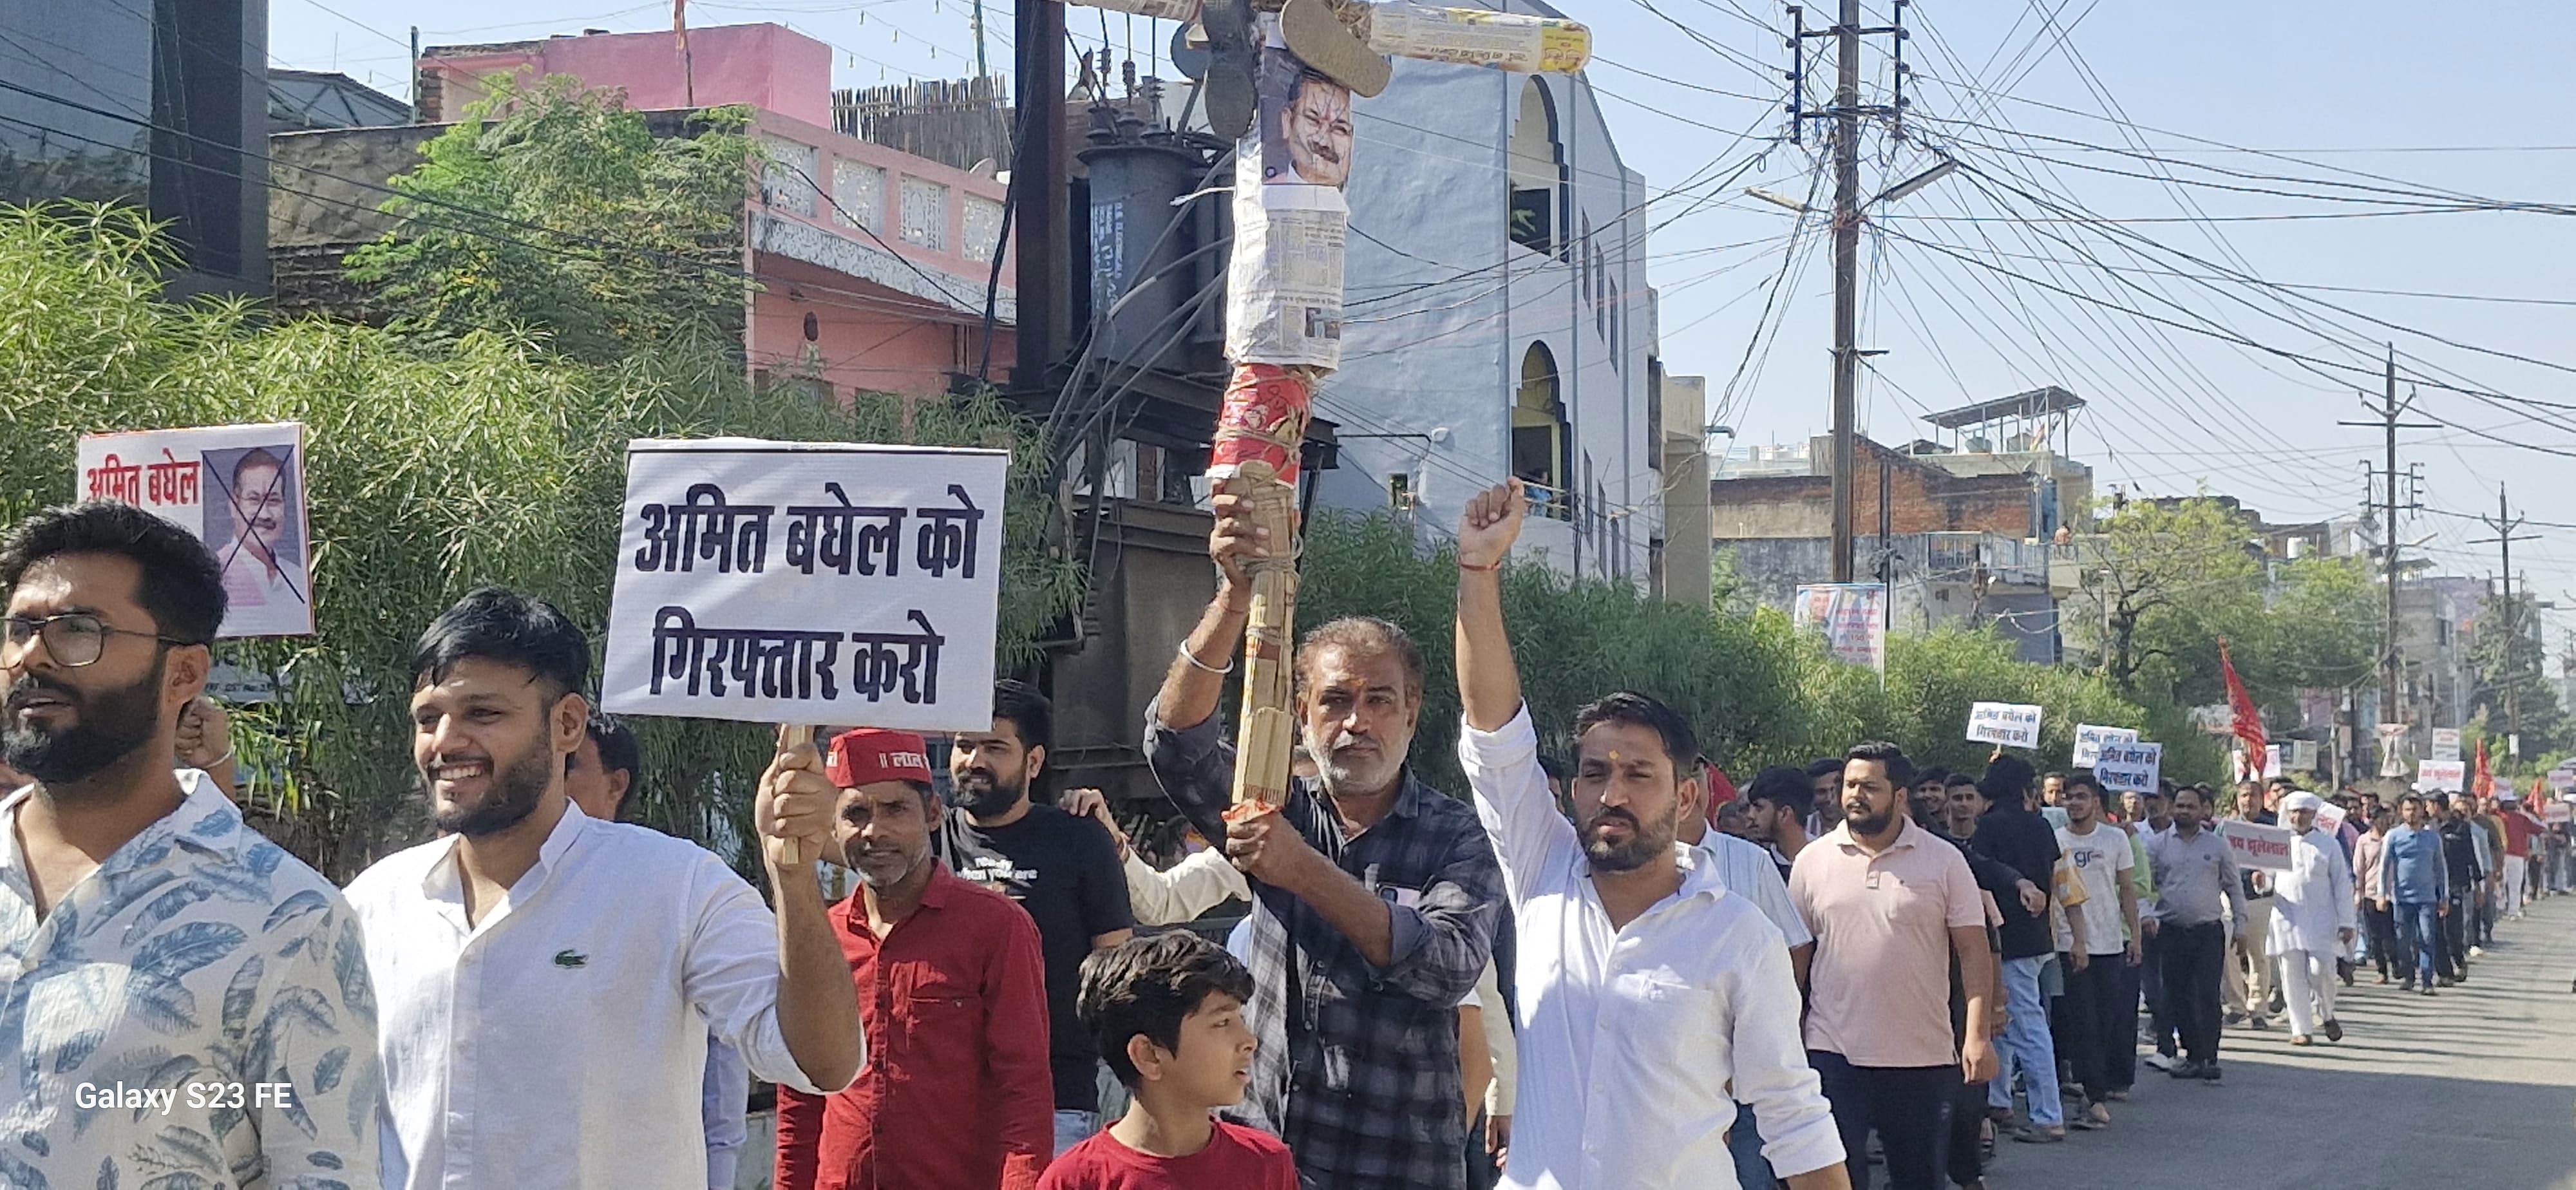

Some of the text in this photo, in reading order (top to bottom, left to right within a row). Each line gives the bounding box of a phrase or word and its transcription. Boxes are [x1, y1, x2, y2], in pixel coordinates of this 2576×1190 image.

[88, 448, 200, 507] अमित बघेल
[635, 482, 984, 578] अमित बघेल को
[650, 606, 945, 704] गिरफ्तार करो
[2024, 710, 2036, 724] को
[1014, 869, 1038, 880] are
